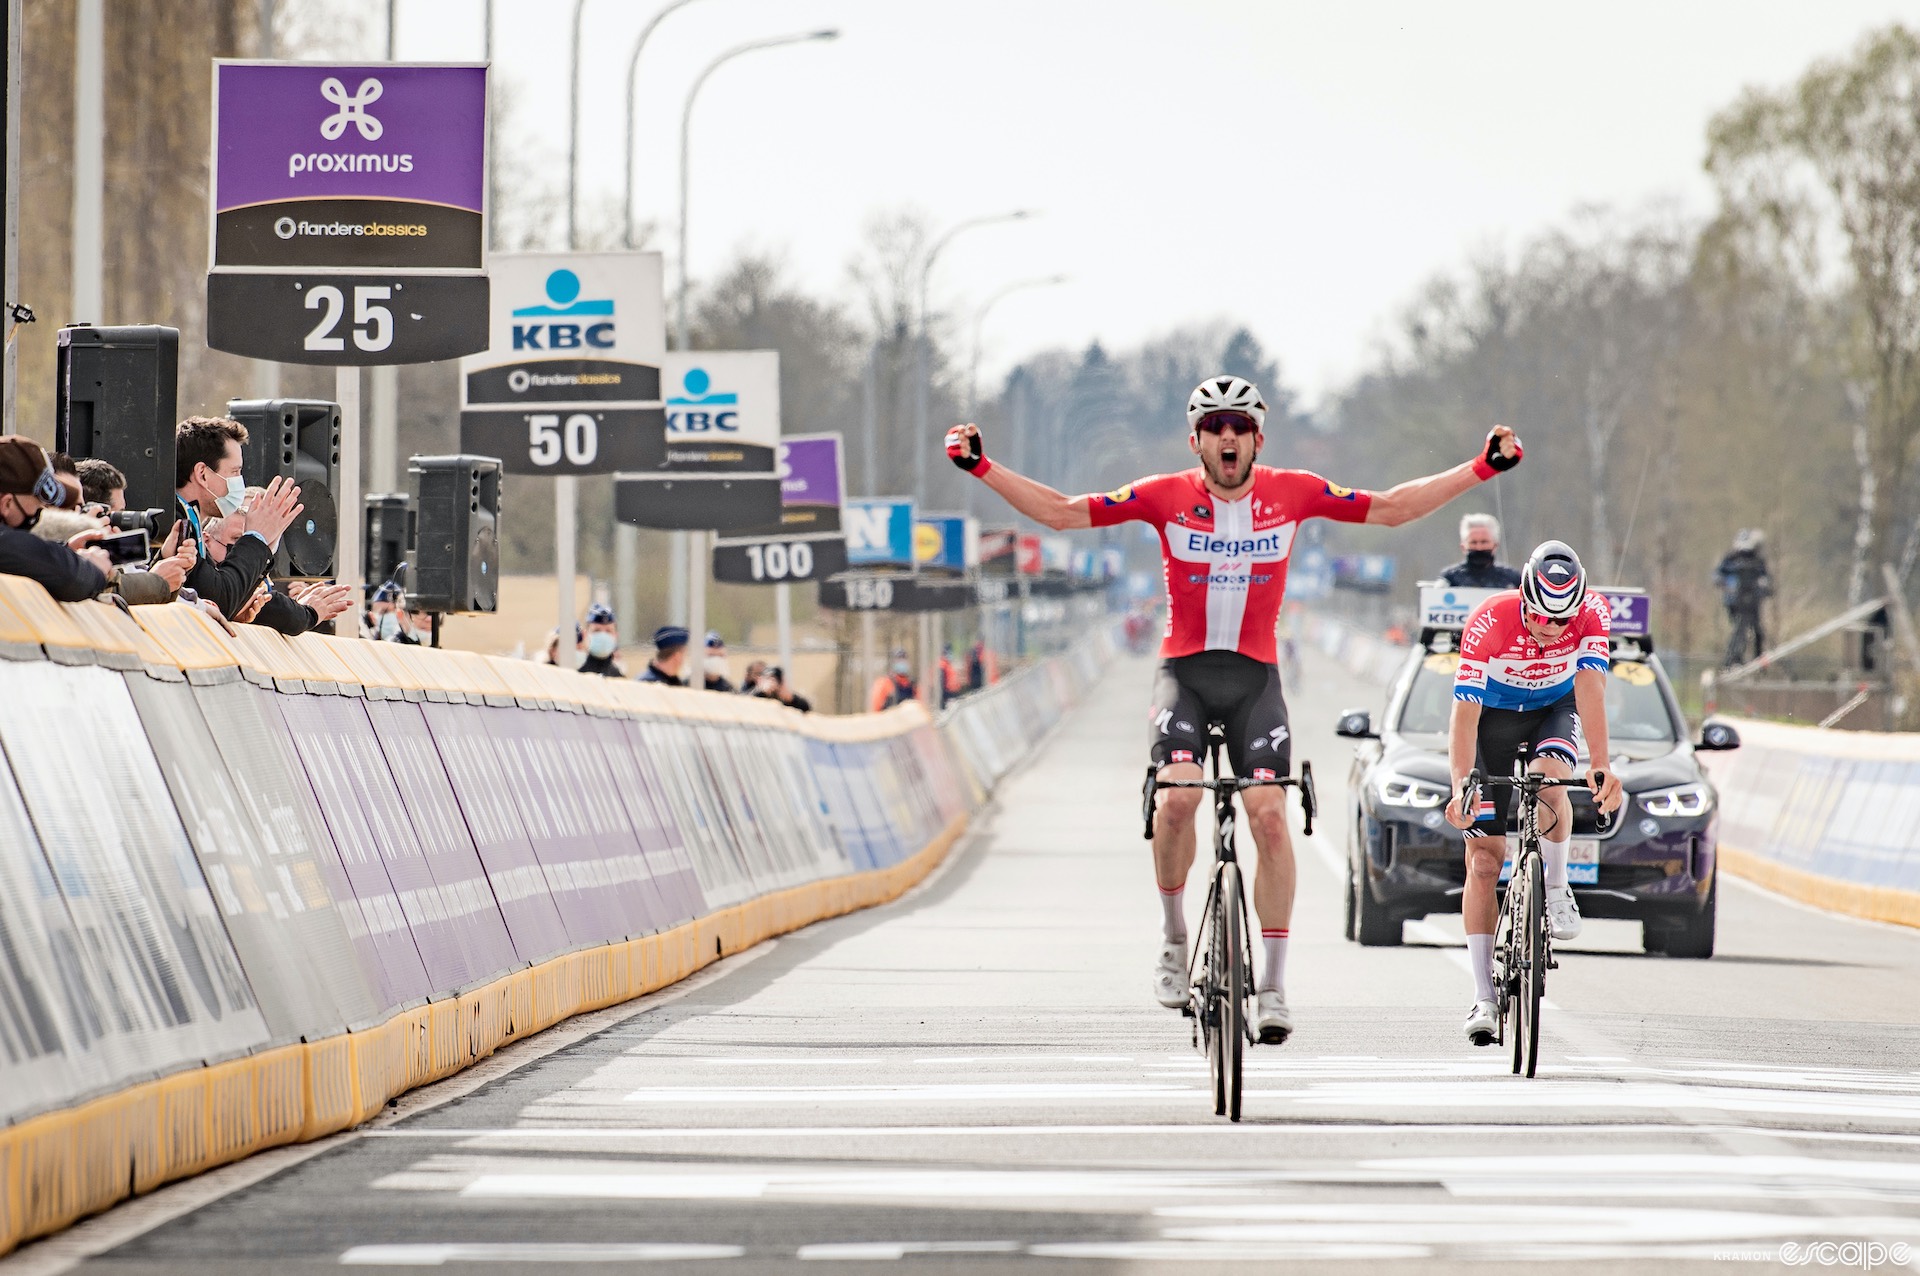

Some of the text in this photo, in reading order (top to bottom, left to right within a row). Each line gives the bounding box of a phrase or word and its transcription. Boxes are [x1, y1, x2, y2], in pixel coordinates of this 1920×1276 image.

[289, 153, 414, 178] proximus
[298, 221, 427, 237] flandersclassics
[304, 285, 394, 352] 25
[512, 323, 615, 350] KBC
[529, 414, 598, 466] 50
[1188, 533, 1279, 557] Elegant
[746, 543, 813, 580] 100
[1583, 593, 1611, 632] Alpecin
[1463, 609, 1498, 656] FENIX
[1506, 678, 1556, 688] FENIX
[1509, 664, 1564, 678] Alpecin
